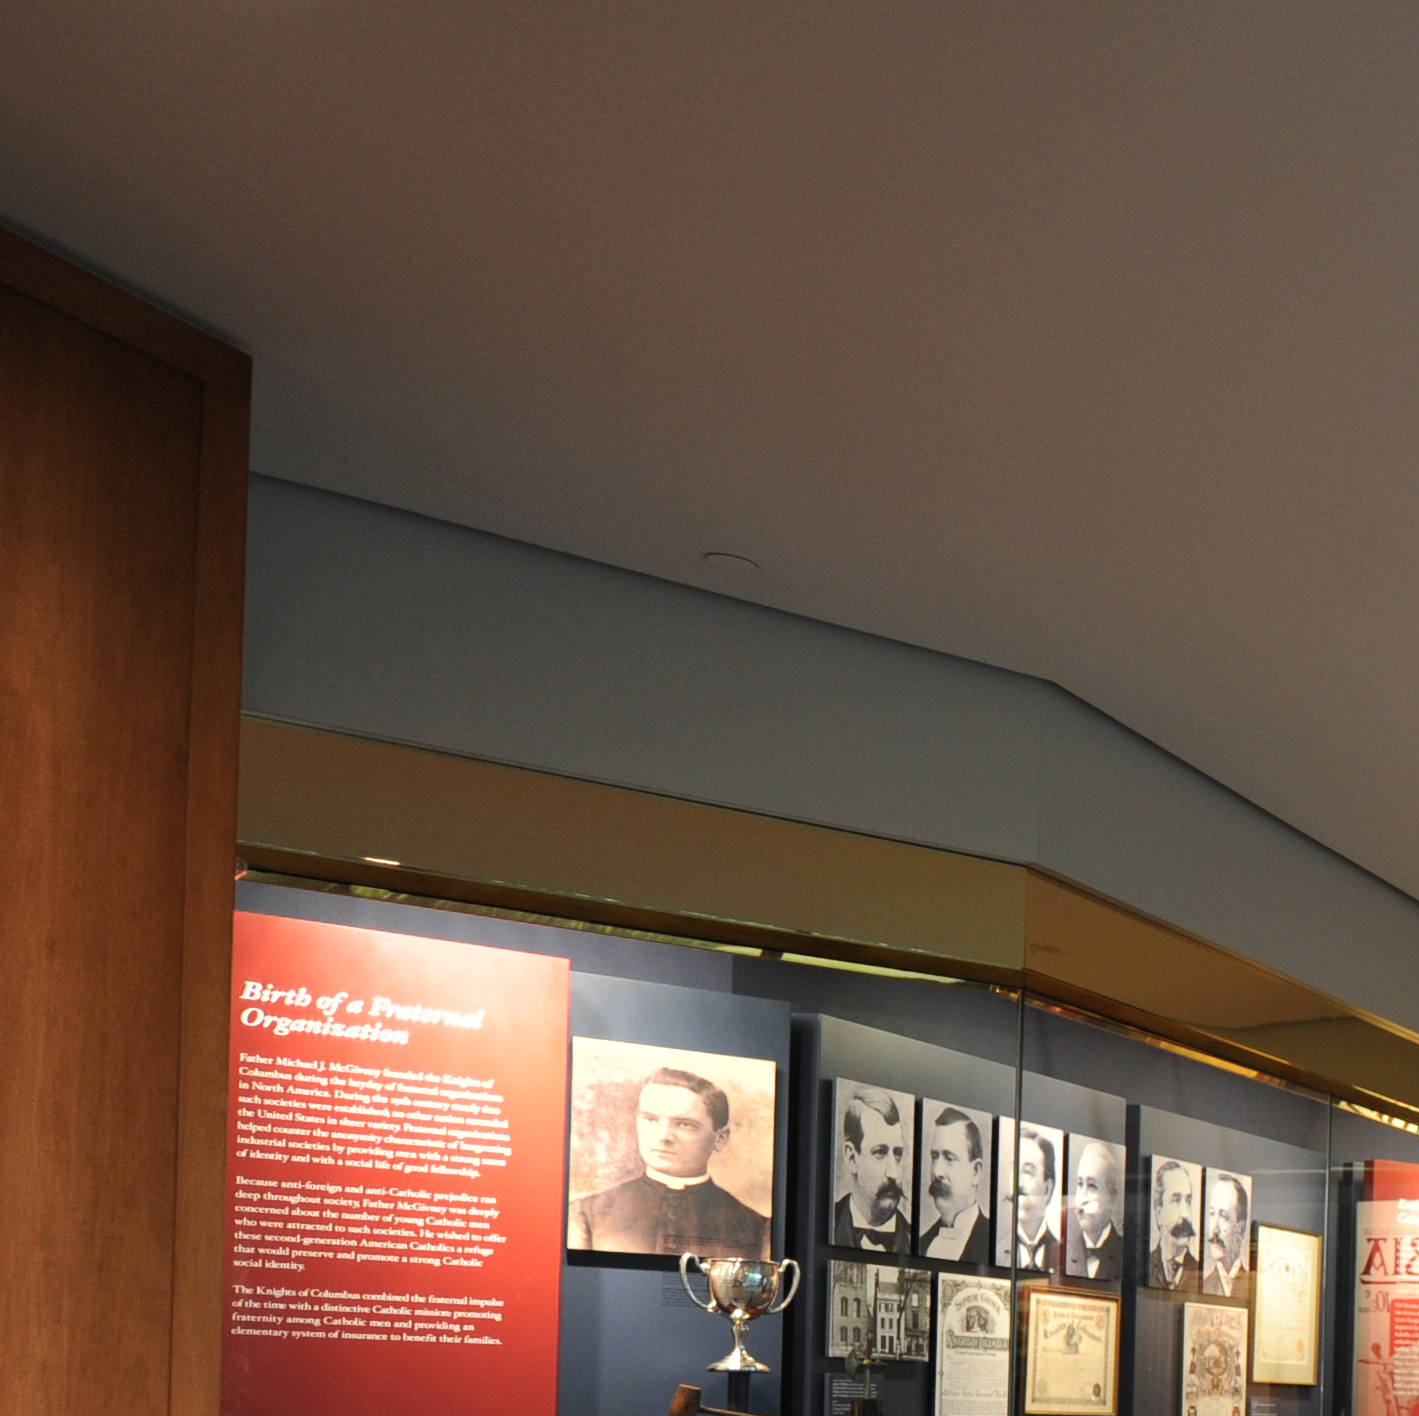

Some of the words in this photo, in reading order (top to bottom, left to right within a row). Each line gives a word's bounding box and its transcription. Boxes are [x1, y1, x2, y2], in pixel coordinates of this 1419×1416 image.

[239, 981, 312, 1007] Birth
[316, 991, 349, 1016] of
[346, 998, 364, 1014] a
[368, 995, 486, 1030] Fraternal
[240, 1007, 410, 1045] Organization
[235, 1175, 278, 1187] Because
[280, 1180, 342, 1193] anti-foreign
[344, 1184, 363, 1193] and
[365, 1187, 431, 1199] anti-Catholic
[234, 1189, 260, 1201] deep
[262, 1191, 320, 1204] throughout
[362, 1198, 394, 1209] Father
[234, 1205, 289, 1215] concerned
[290, 1206, 319, 1217] about
[322, 1209, 339, 1218] the
[341, 1211, 379, 1221] number
[381, 1213, 393, 1222] of
[394, 1216, 424, 1226] young
[425, 1216, 466, 1227] Catholic
[234, 1216, 257, 1226] who
[259, 1220, 283, 1228] were
[286, 1222, 332, 1231] attracted
[347, 1224, 370, 1233] such
[372, 1227, 416, 1236] societies.
[419, 1228, 434, 1238] He
[436, 1230, 469, 1240] wished
[234, 1230, 261, 1240] these
[264, 1234, 357, 1246] second-generation
[359, 1238, 407, 1249] American
[409, 1241, 454, 1252] Catholics
[233, 1243, 254, 1253] that
[257, 1246, 289, 1255] would
[291, 1249, 334, 1258] preserve
[336, 1250, 355, 1259] and
[356, 1253, 399, 1262] promote
[409, 1256, 440, 1267] strong
[442, 1256, 483, 1267] Catholic
[233, 1258, 262, 1267] social
[232, 1284, 253, 1294] The
[256, 1285, 296, 1298] Knights
[297, 1288, 309, 1296] of
[310, 1288, 360, 1299] Columbus
[361, 1291, 409, 1302] combined
[410, 1293, 426, 1302] the
[428, 1294, 467, 1304] fraternal
[231, 1298, 243, 1307] of
[244, 1299, 260, 1308] the
[263, 1300, 286, 1309] time
[288, 1301, 311, 1310] with
[320, 1302, 370, 1313] distinctive
[372, 1304, 411, 1315] Catholic
[231, 1311, 283, 1324] fraternity
[286, 1316, 320, 1326] among
[323, 1316, 366, 1326] Catholic
[393, 1319, 412, 1328] and
[414, 1321, 460, 1332] providing
[230, 1325, 288, 1338] elementary
[291, 1330, 325, 1339] system
[327, 1329, 339, 1338] of
[341, 1330, 387, 1340] insurance
[402, 1332, 436, 1342] benefit
[438, 1334, 461, 1343] their
[463, 1334, 502, 1344] families.
